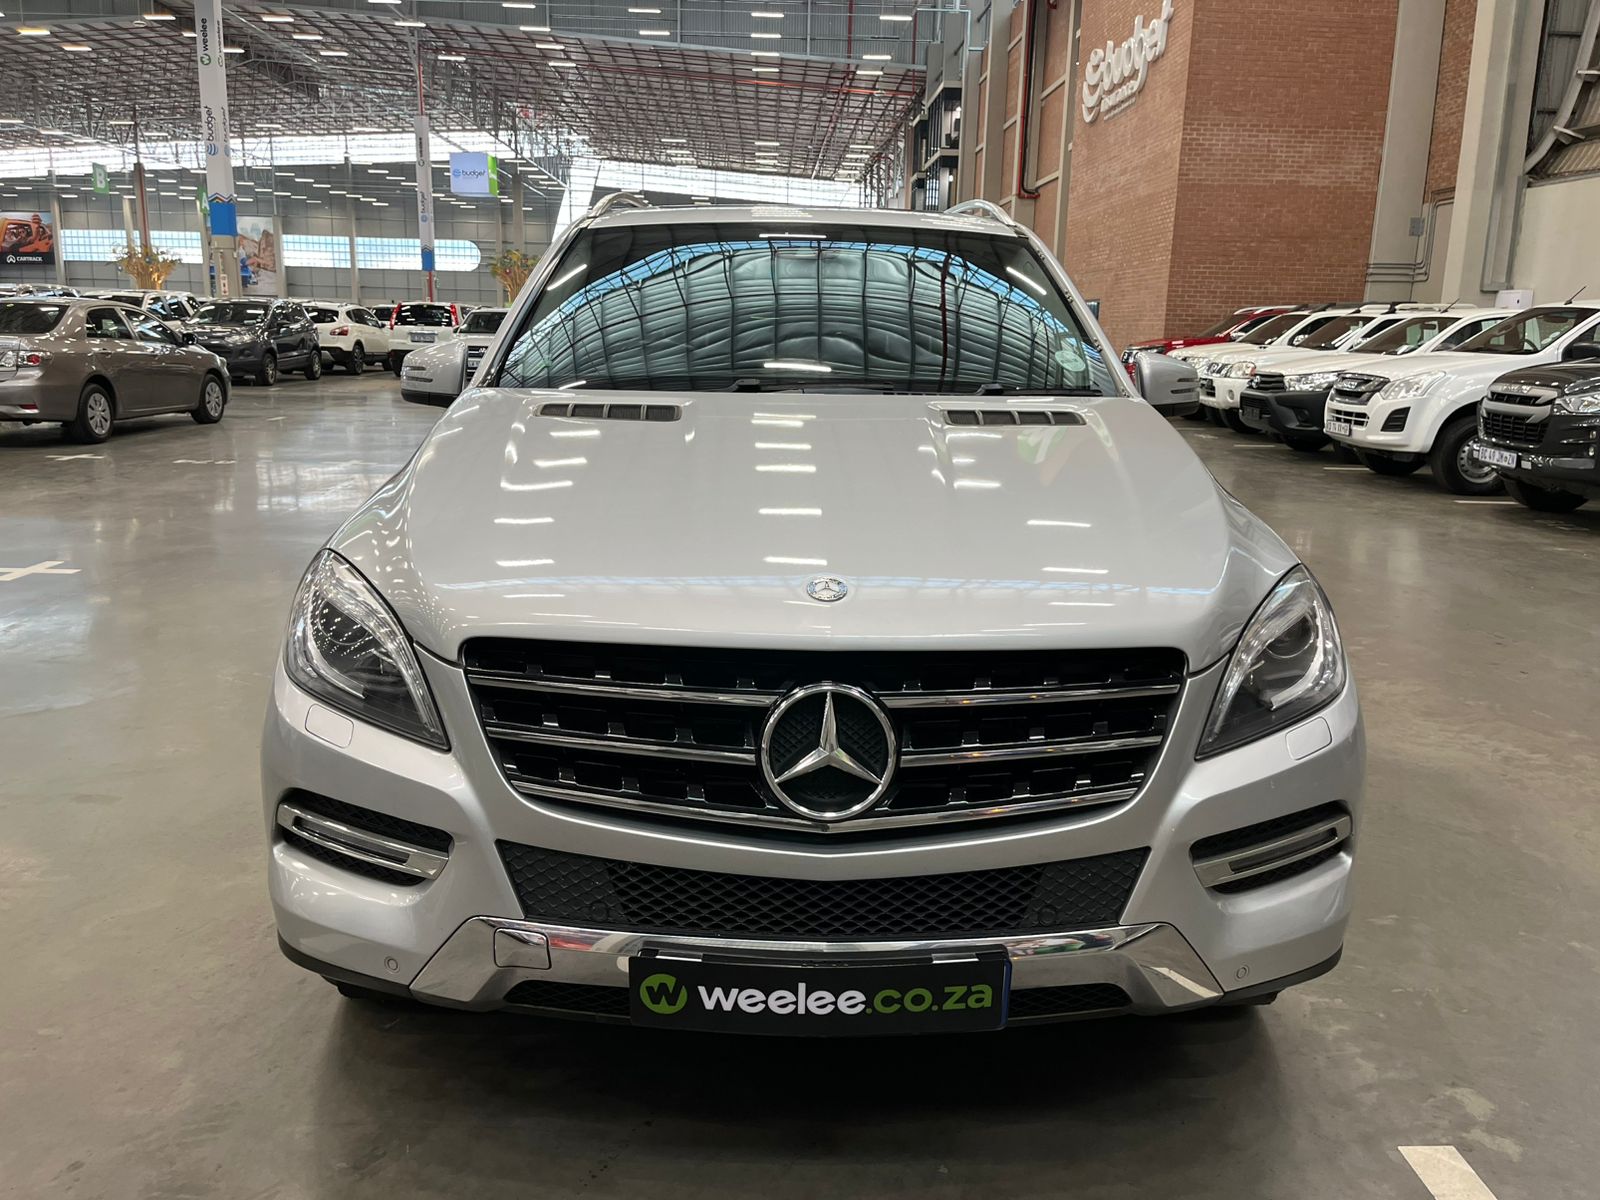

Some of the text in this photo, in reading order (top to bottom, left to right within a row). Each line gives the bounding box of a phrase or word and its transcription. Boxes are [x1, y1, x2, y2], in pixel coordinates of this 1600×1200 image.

[200, 17, 209, 52] weelee
[204, 105, 216, 142] budget
[96, 167, 106, 188] B
[461, 169, 486, 179] budget
[201, 192, 210, 210] A
[697, 983, 993, 1015] weelee.co.za
